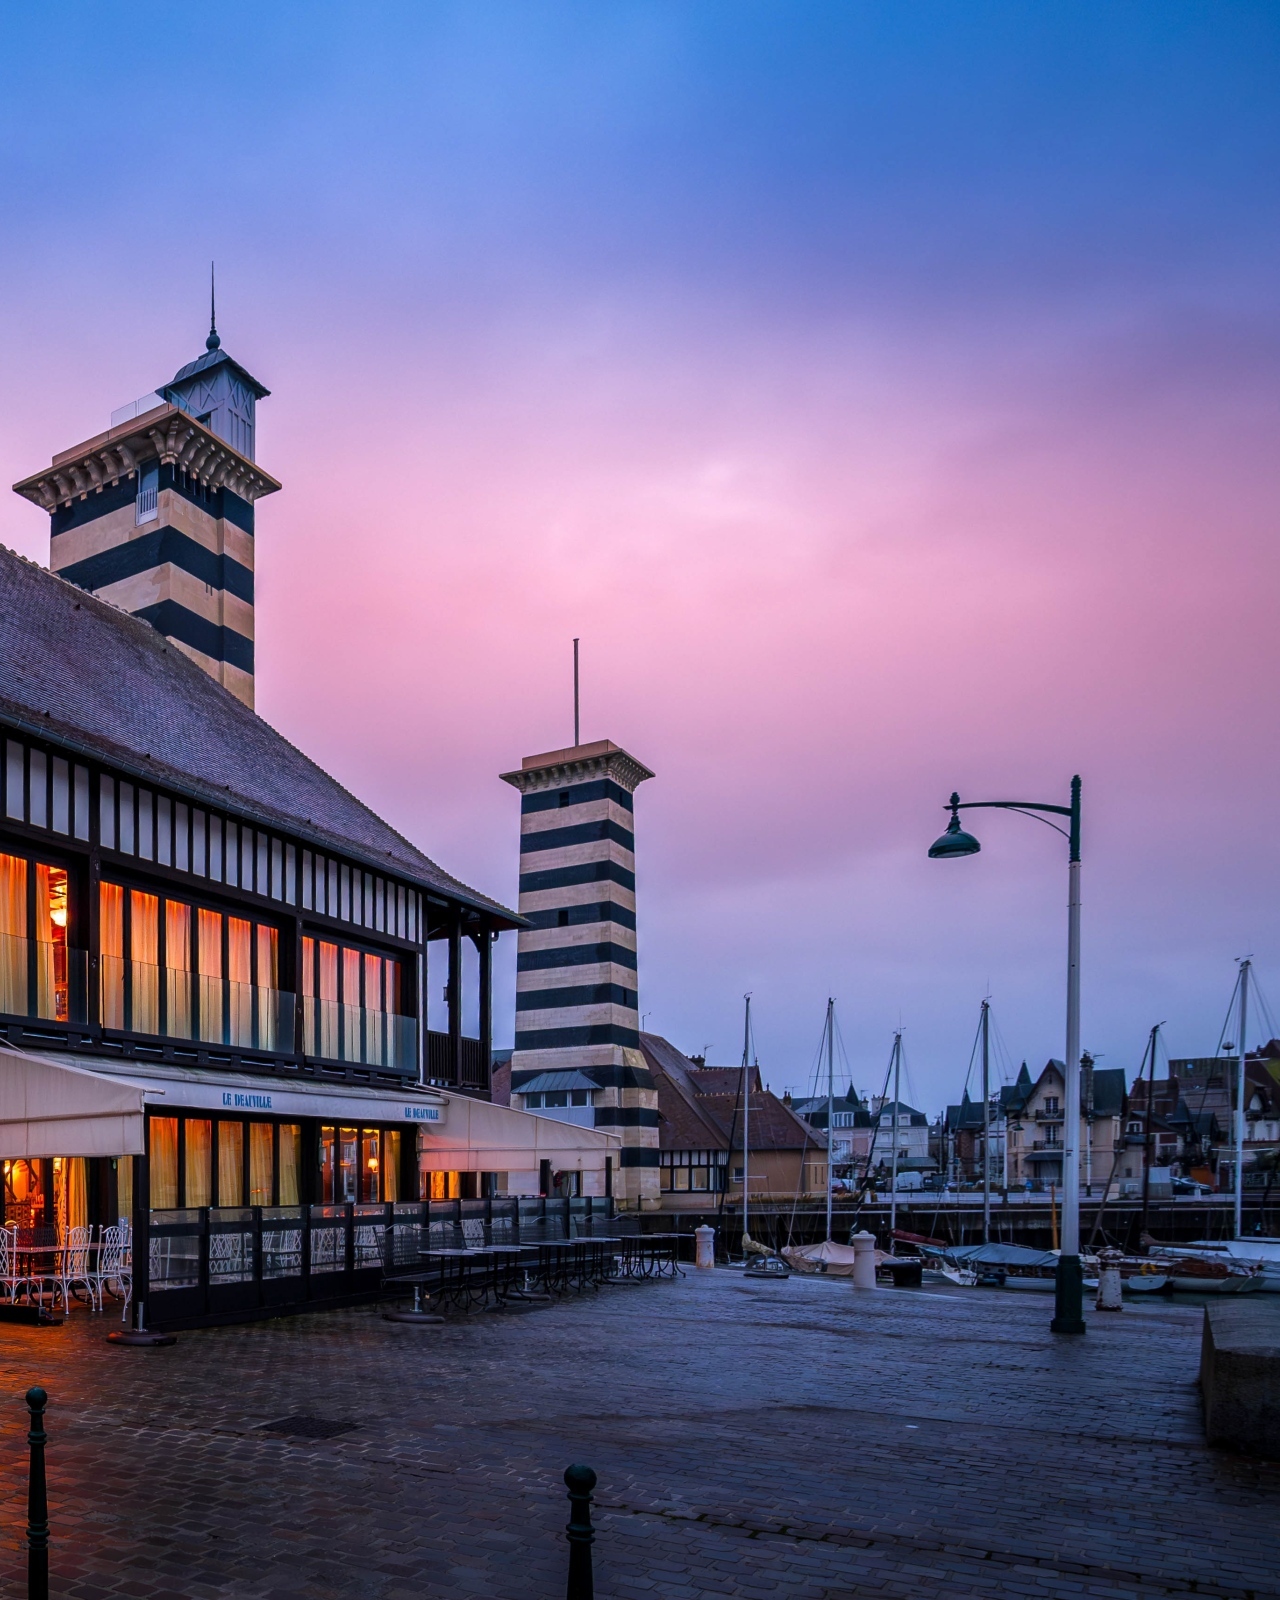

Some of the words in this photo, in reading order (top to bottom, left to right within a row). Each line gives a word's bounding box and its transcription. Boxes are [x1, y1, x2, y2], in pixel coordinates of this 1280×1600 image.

[222, 1092, 232, 1106] LE
[234, 1093, 273, 1109] DEAUVILLE
[404, 1106, 412, 1118] LE
[412, 1107, 439, 1120] DEAUVILLE
